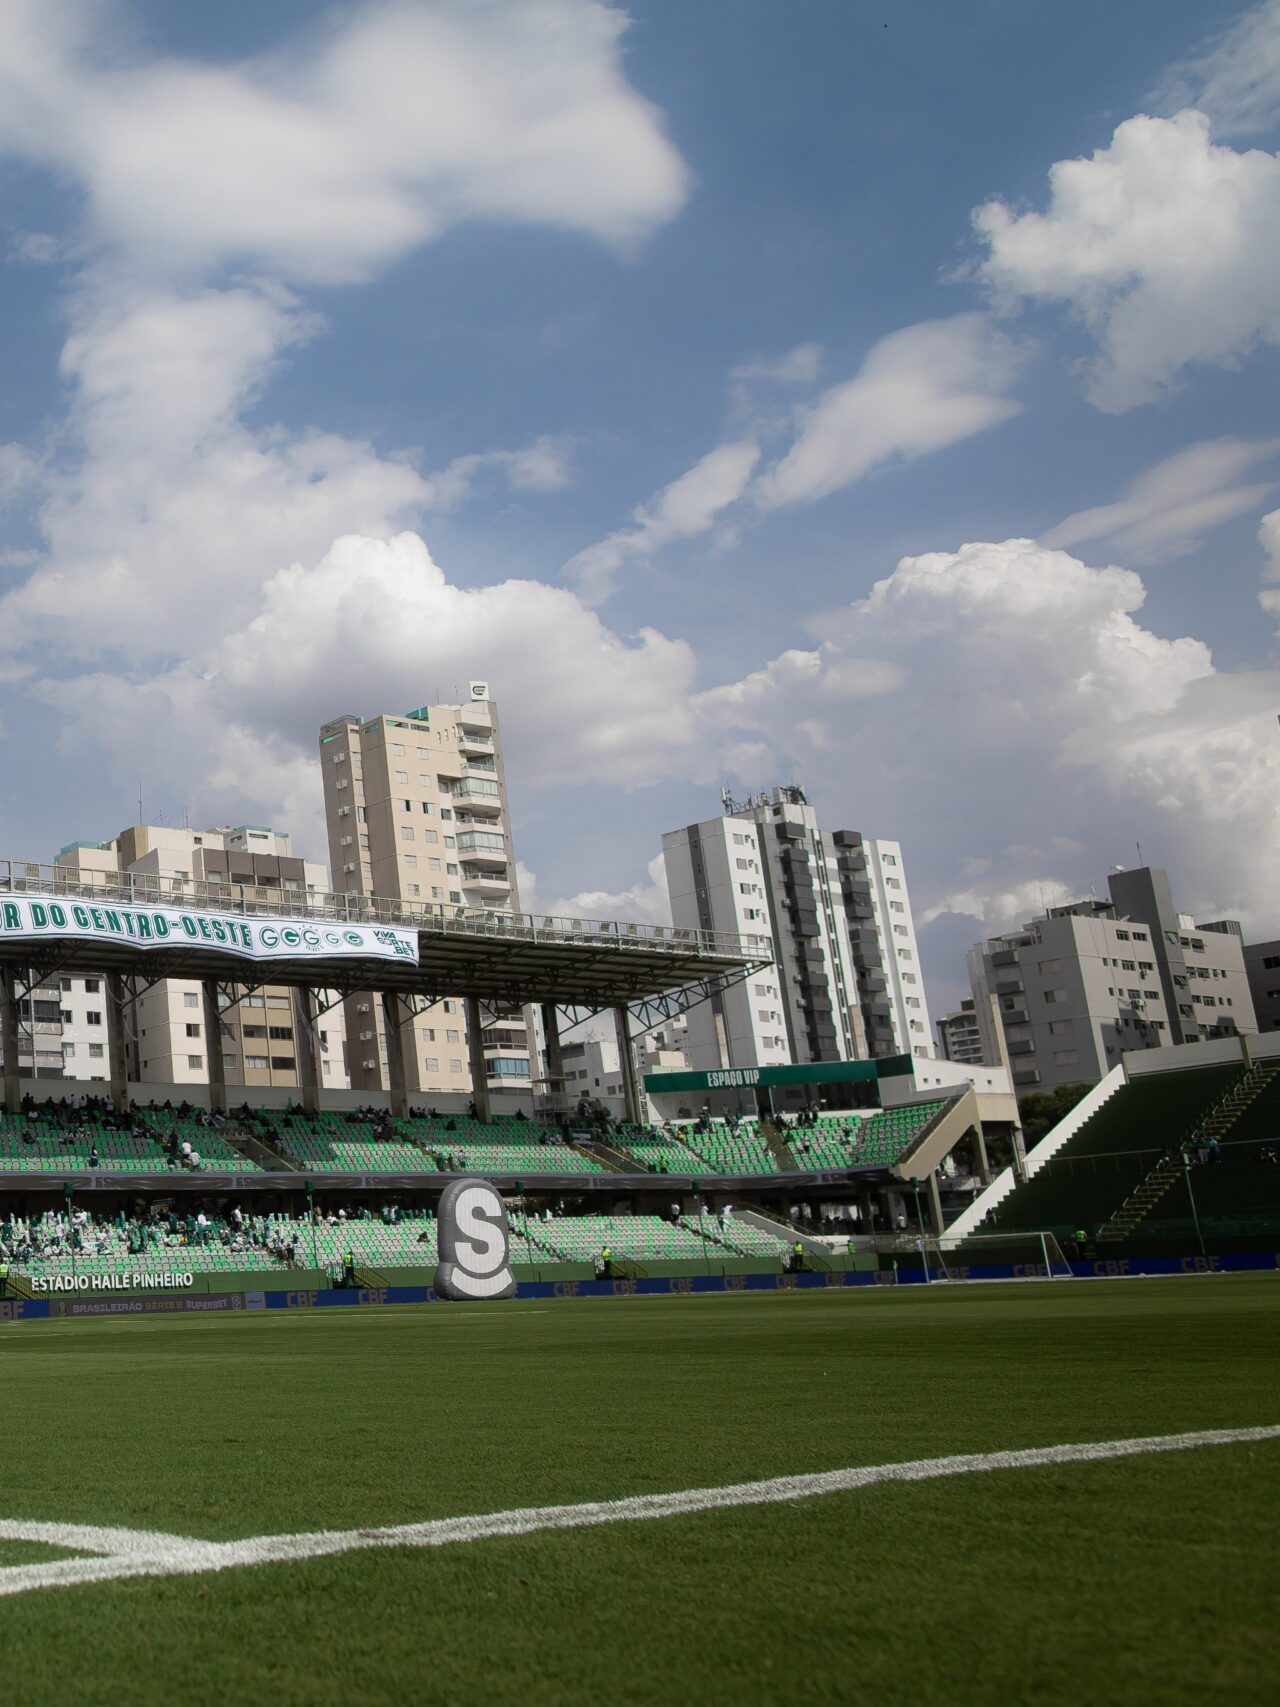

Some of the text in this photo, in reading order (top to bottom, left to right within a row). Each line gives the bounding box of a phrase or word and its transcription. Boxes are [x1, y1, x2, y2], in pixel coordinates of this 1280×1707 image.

[31, 901, 69, 930] DO
[74, 905, 255, 951] CENTRO-OESTE
[373, 930, 397, 940] VIVA
[376, 937, 413, 951] SORTE
[393, 945, 415, 957] .BET
[707, 1069, 760, 1088] ESPAÇO VIP
[454, 1187, 507, 1274] S
[1092, 1259, 1130, 1276] CBF
[1180, 1256, 1220, 1274] CBF
[31, 1272, 194, 1292] ESTÁDIO HAILÉ PINHEIRO
[553, 1280, 580, 1297] CBF
[611, 1279, 637, 1295] CBF
[286, 1291, 318, 1308] CBF
[358, 1288, 388, 1305] CBF
[73, 1301, 143, 1313] BRASILEIRÃO
[186, 1298, 228, 1310] SUPERBET
